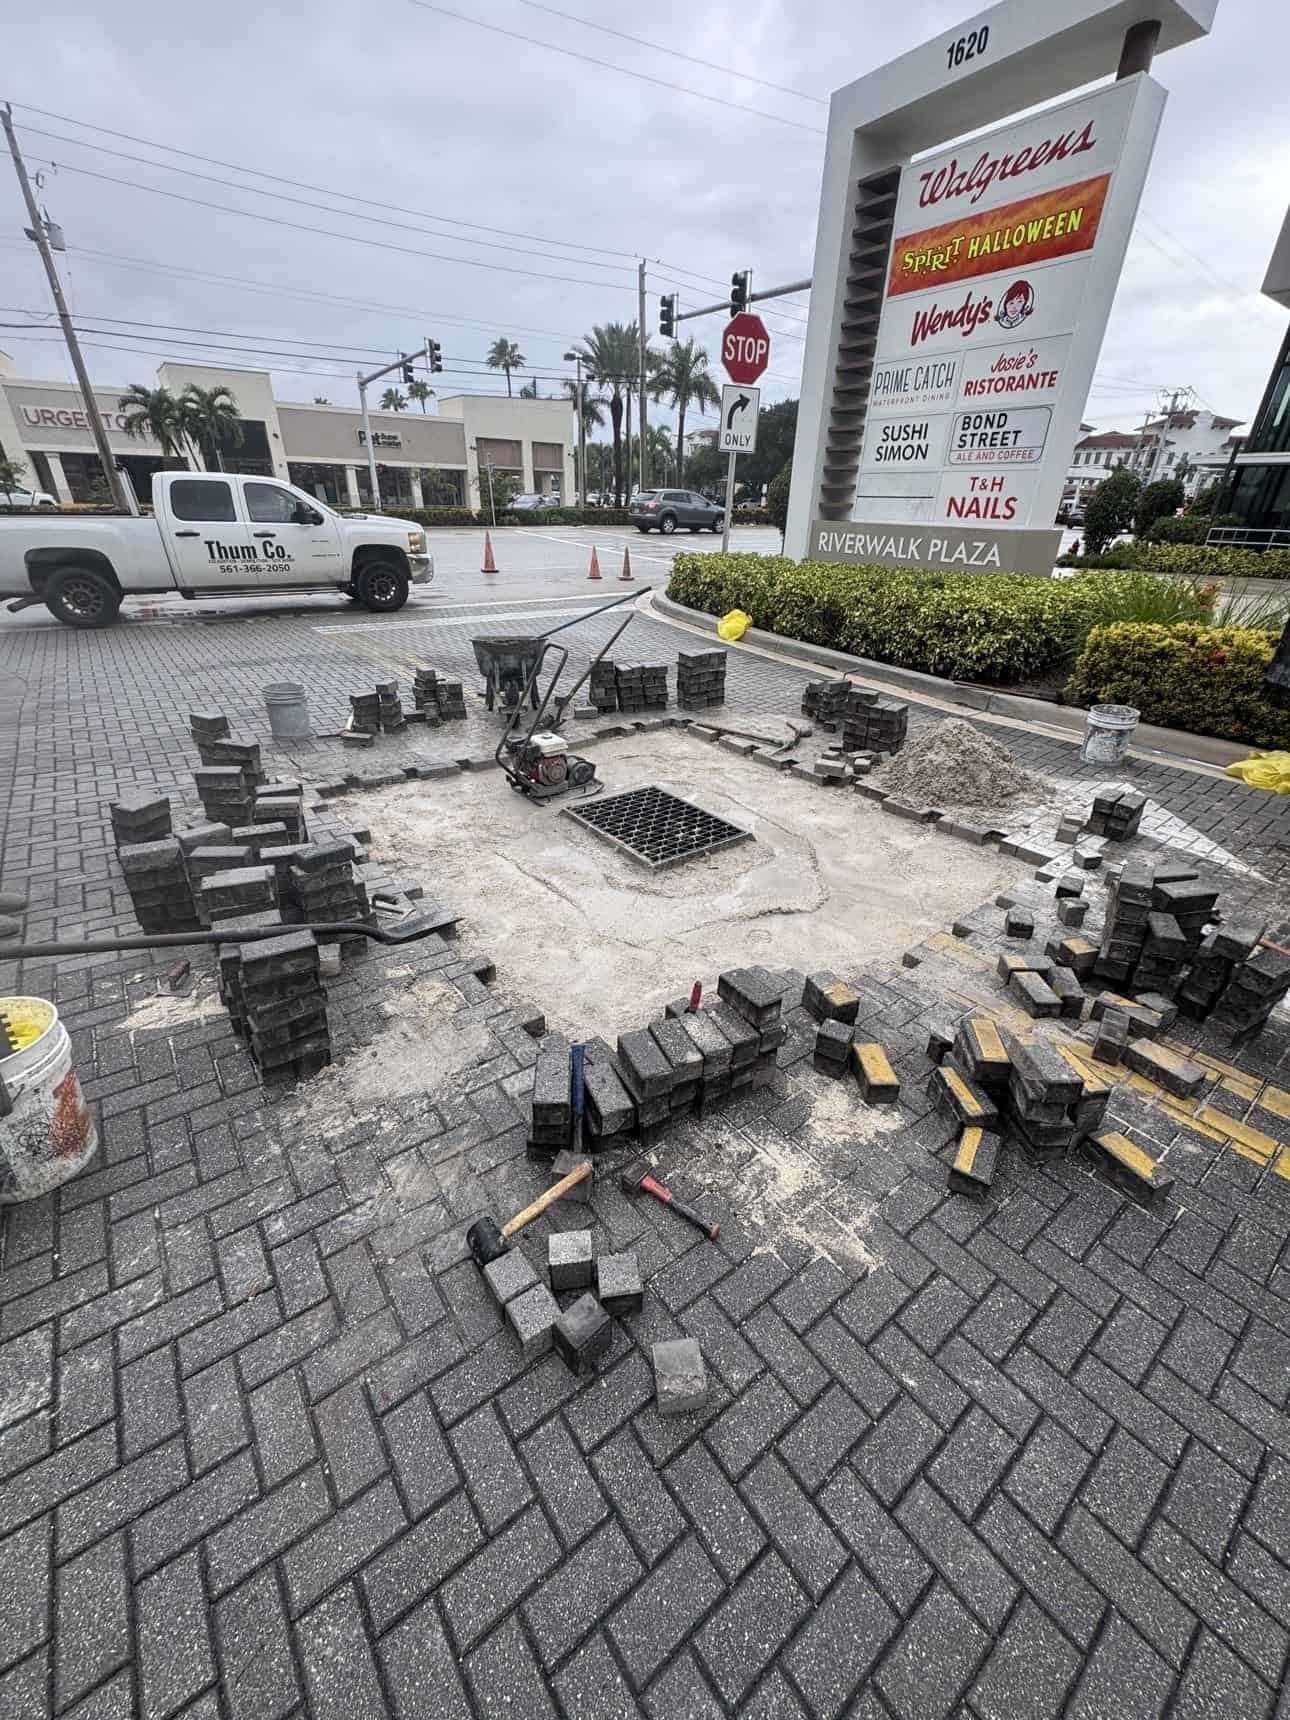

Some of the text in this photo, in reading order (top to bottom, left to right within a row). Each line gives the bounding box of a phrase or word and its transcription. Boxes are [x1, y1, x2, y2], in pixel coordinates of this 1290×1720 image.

[947, 26, 990, 69] 1620
[919, 120, 1097, 208] Walgreens
[902, 207, 1084, 275] SPIRIT HALLOWEEN
[911, 291, 992, 346] Wendy's
[725, 334, 767, 364] STOP
[991, 347, 1038, 373] Josie's
[875, 361, 956, 396] PRIME CATCH
[964, 371, 1058, 398] RISTORANTE
[24, 407, 113, 429] URGET
[962, 413, 1008, 431] BOND
[724, 433, 751, 447] ONLY
[882, 423, 928, 442] SUSHI
[957, 430, 1022, 448] STREET
[875, 443, 929, 462] SIMON
[956, 449, 1035, 461] ALE AND COFFEE
[946, 496, 1018, 519] NAILS
[204, 540, 292, 560] Thum Co.
[817, 531, 1001, 567] RIVERWALK PLAZA
[219, 564, 290, 574] 561-366-2050
